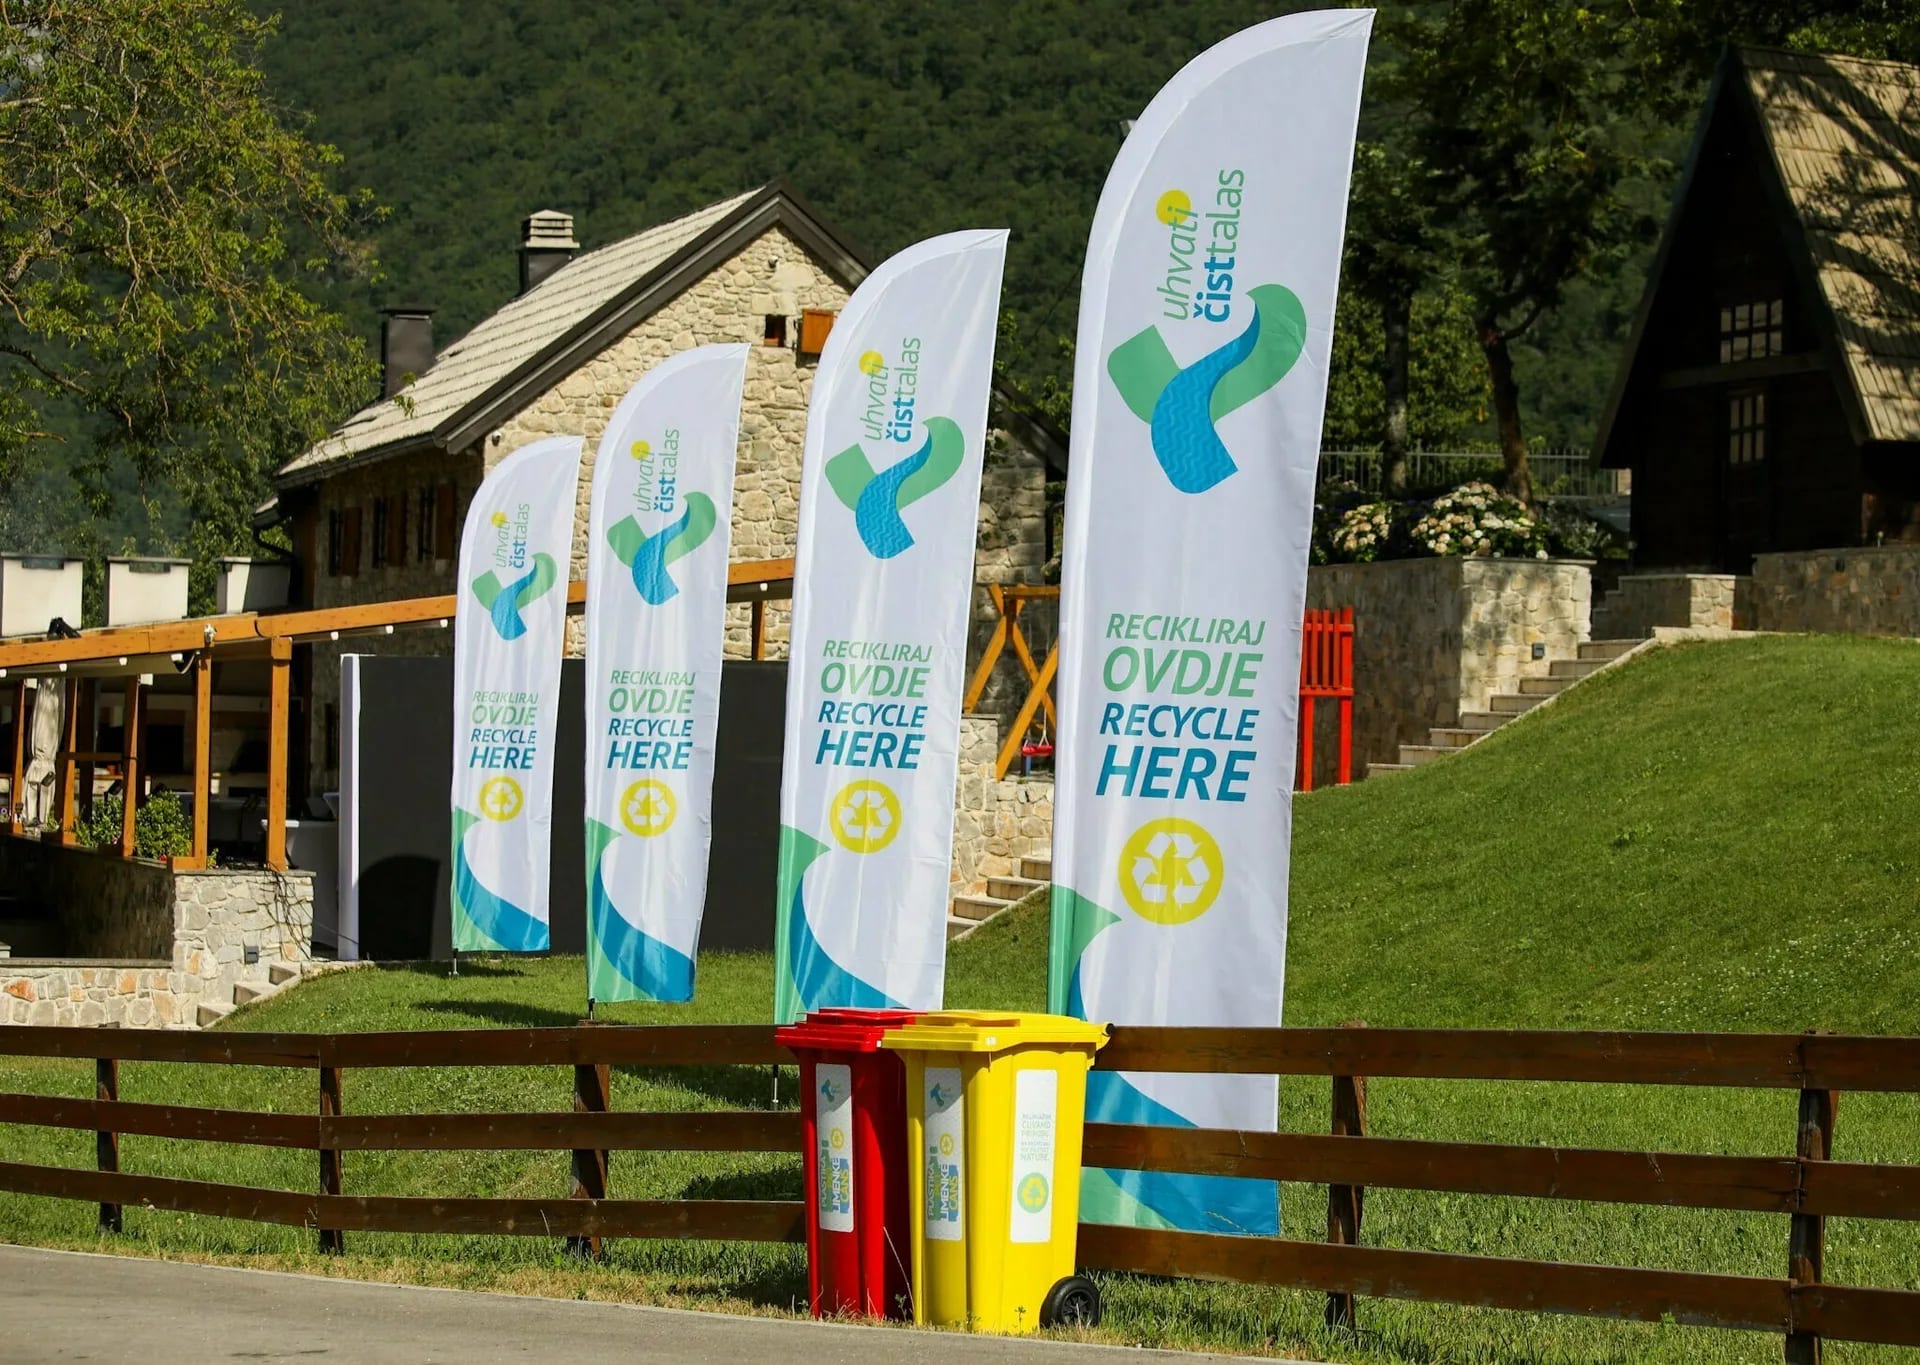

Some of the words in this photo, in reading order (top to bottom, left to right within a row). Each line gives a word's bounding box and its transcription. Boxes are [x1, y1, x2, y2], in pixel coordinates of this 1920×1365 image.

[1156, 204, 1199, 321] uhvati
[860, 361, 889, 441] uhvati
[633, 449, 655, 512] uhvati
[1105, 613, 1266, 646] RECIKLIRAJ
[822, 639, 933, 662] RECIKLIRAJ
[609, 669, 696, 686] RECIKLIRAJ
[820, 662, 931, 698] OVDJE
[1103, 646, 1264, 698] OVDJE
[472, 690, 539, 704] RECIKLIRAJ
[608, 687, 695, 714] OVDJE
[817, 700, 929, 728] RECYCLE
[471, 704, 538, 726] OVDJE
[608, 717, 695, 737] RECYCLE
[1099, 702, 1260, 742] RECYCLE
[470, 728, 537, 744] RECYCLE
[815, 729, 926, 769] HERE
[469, 746, 537, 770] HERE
[606, 740, 694, 770] HERE
[1095, 744, 1258, 802] HERE
[831, 1157, 841, 1214] LIMENKE
[840, 1168, 849, 1203] CANS
[940, 1163, 949, 1222] LIMENKE
[949, 1175, 958, 1211] CANS
